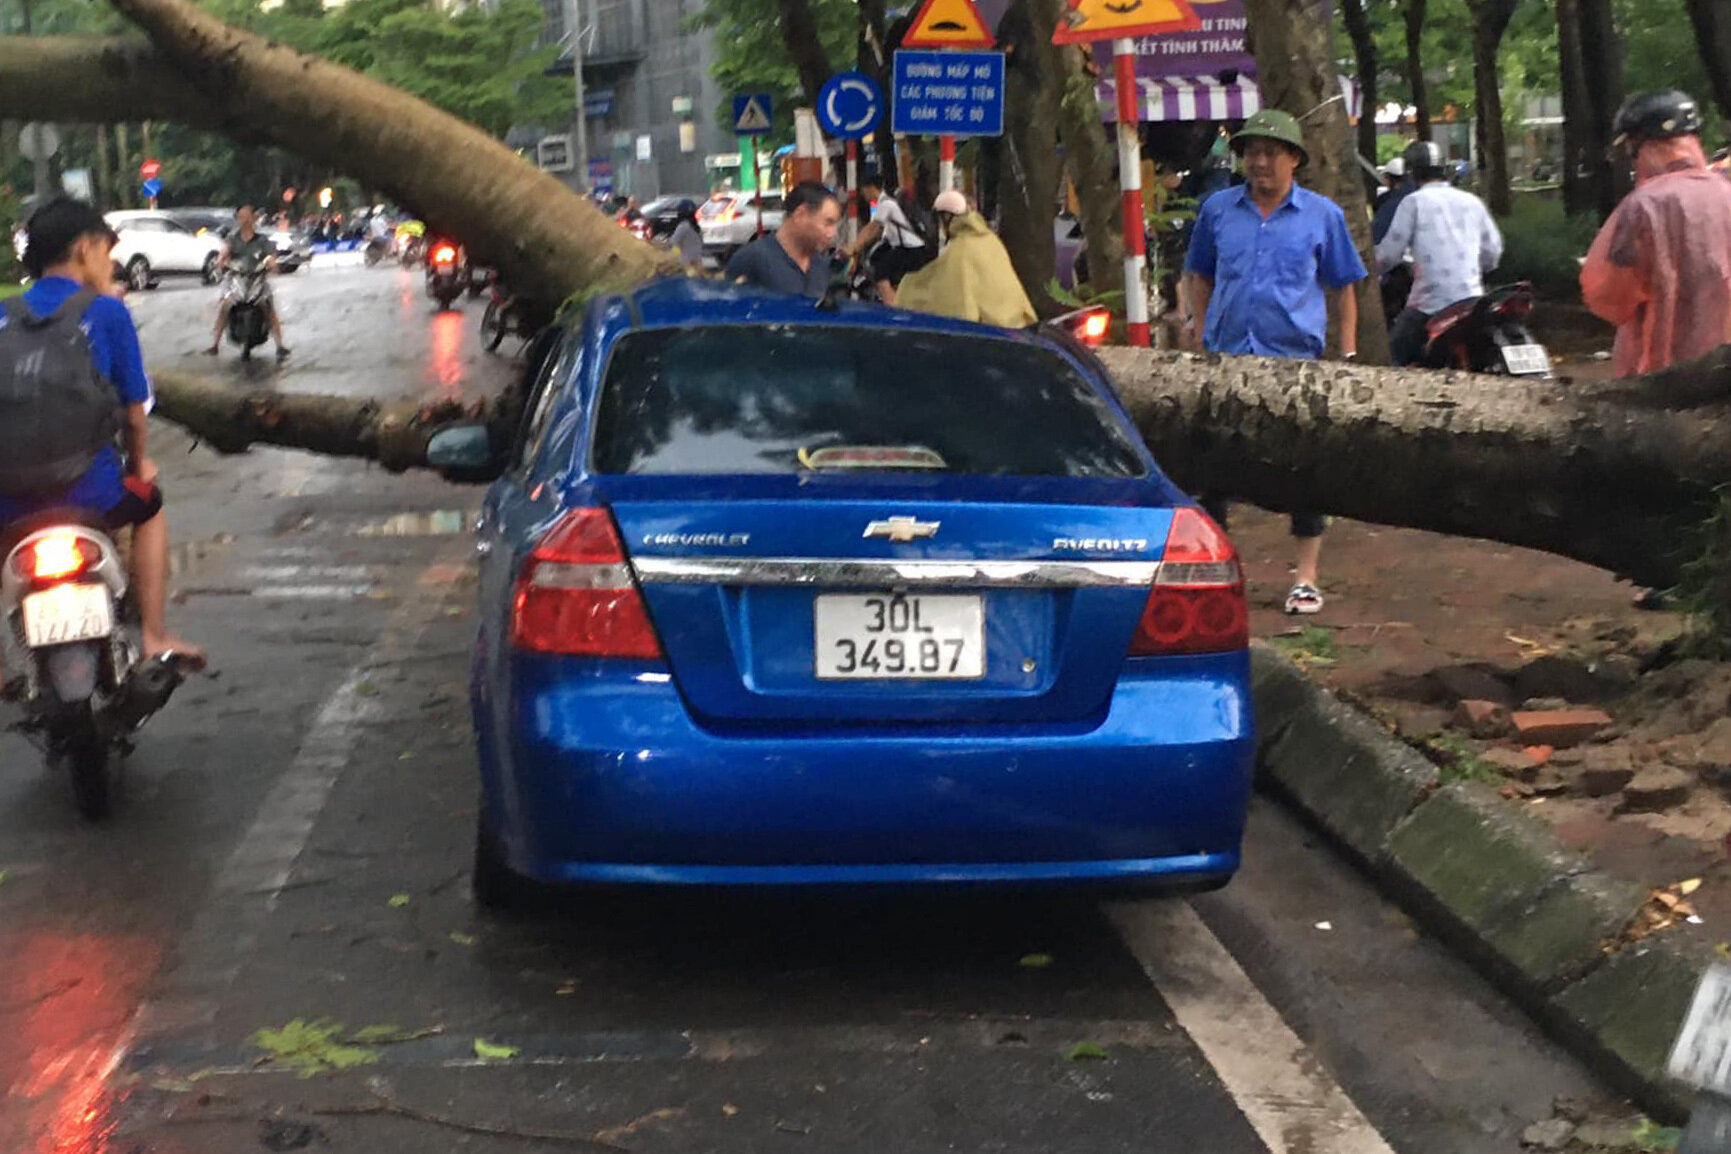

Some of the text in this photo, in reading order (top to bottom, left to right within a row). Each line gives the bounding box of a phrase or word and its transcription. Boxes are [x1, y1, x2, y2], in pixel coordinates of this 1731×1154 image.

[642, 532, 750, 546] CHEVROLET
[865, 598, 933, 632] 30L
[835, 638, 966, 673] 349.87
